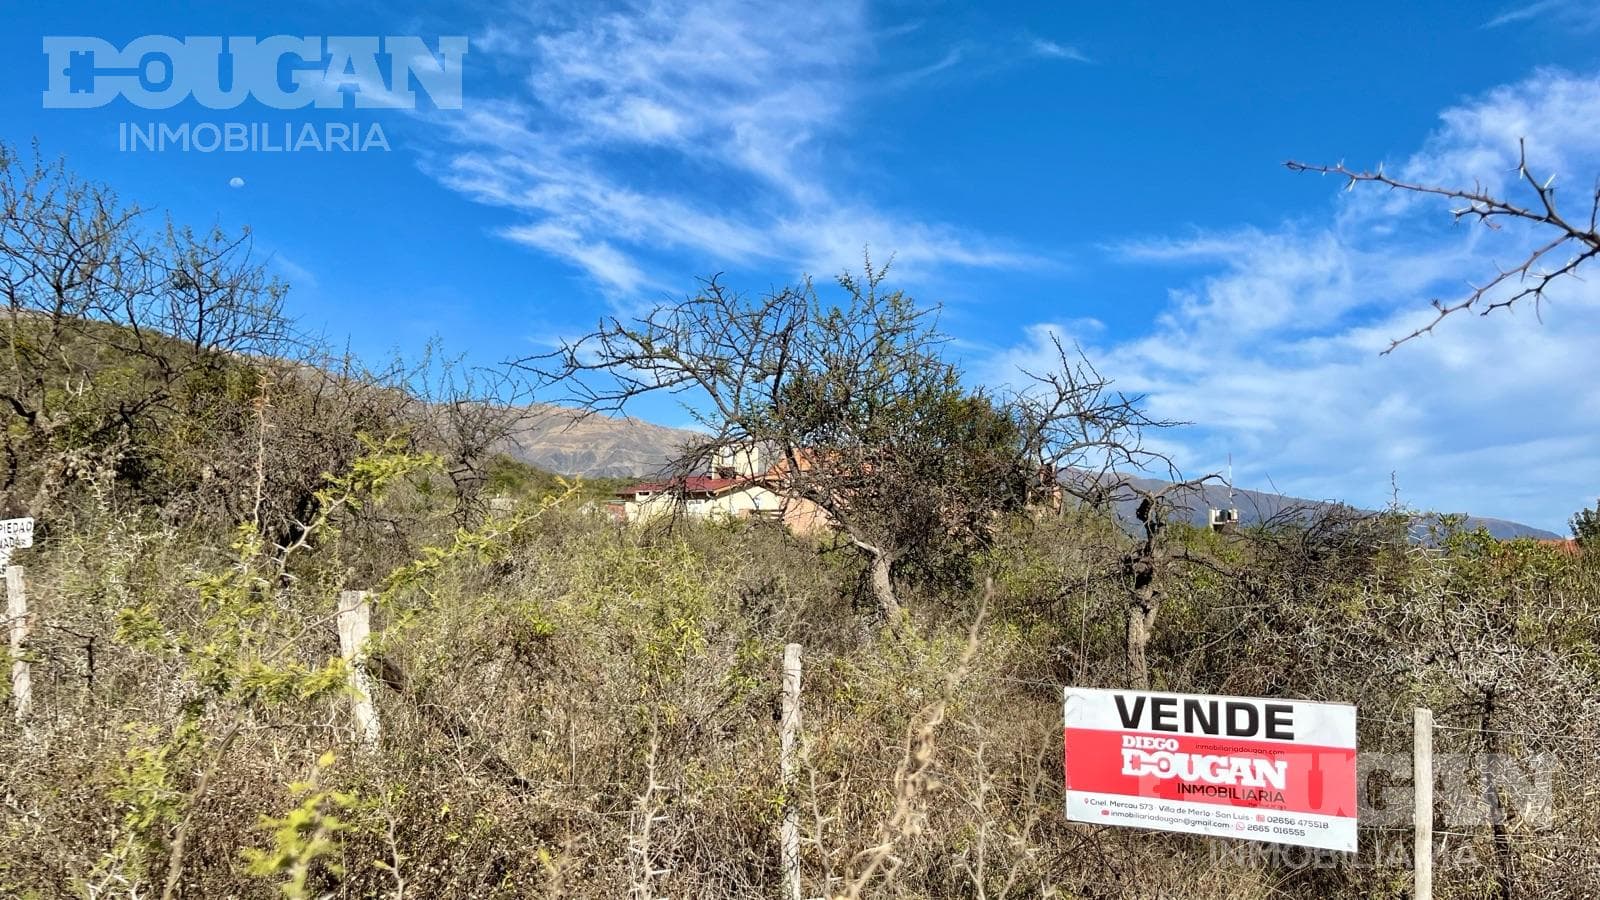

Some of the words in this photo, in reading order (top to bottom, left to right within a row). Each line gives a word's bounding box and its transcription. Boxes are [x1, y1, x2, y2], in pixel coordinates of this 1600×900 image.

[1114, 695, 1295, 740] VENDE
[1122, 735, 1179, 752] DIEGO
[1195, 743, 1286, 756] inmobiliariadougan.com
[1121, 749, 1288, 789] DOUGAN
[1177, 783, 1286, 804] INMOBILIARIA
[1110, 800, 1138, 810] Mercau
[1139, 803, 1154, 811] 573
[1158, 805, 1175, 814] Villa
[1176, 807, 1186, 815] de
[1187, 808, 1211, 818] Merlo
[1215, 811, 1232, 820] San
[1233, 811, 1250, 821] Luis
[1267, 815, 1296, 826] 02656
[1298, 819, 1330, 830] 475518
[1111, 811, 1230, 829] inmobiliariadougan@gmail.com
[1247, 824, 1270, 833] 2665
[1273, 828, 1306, 838] 016555
